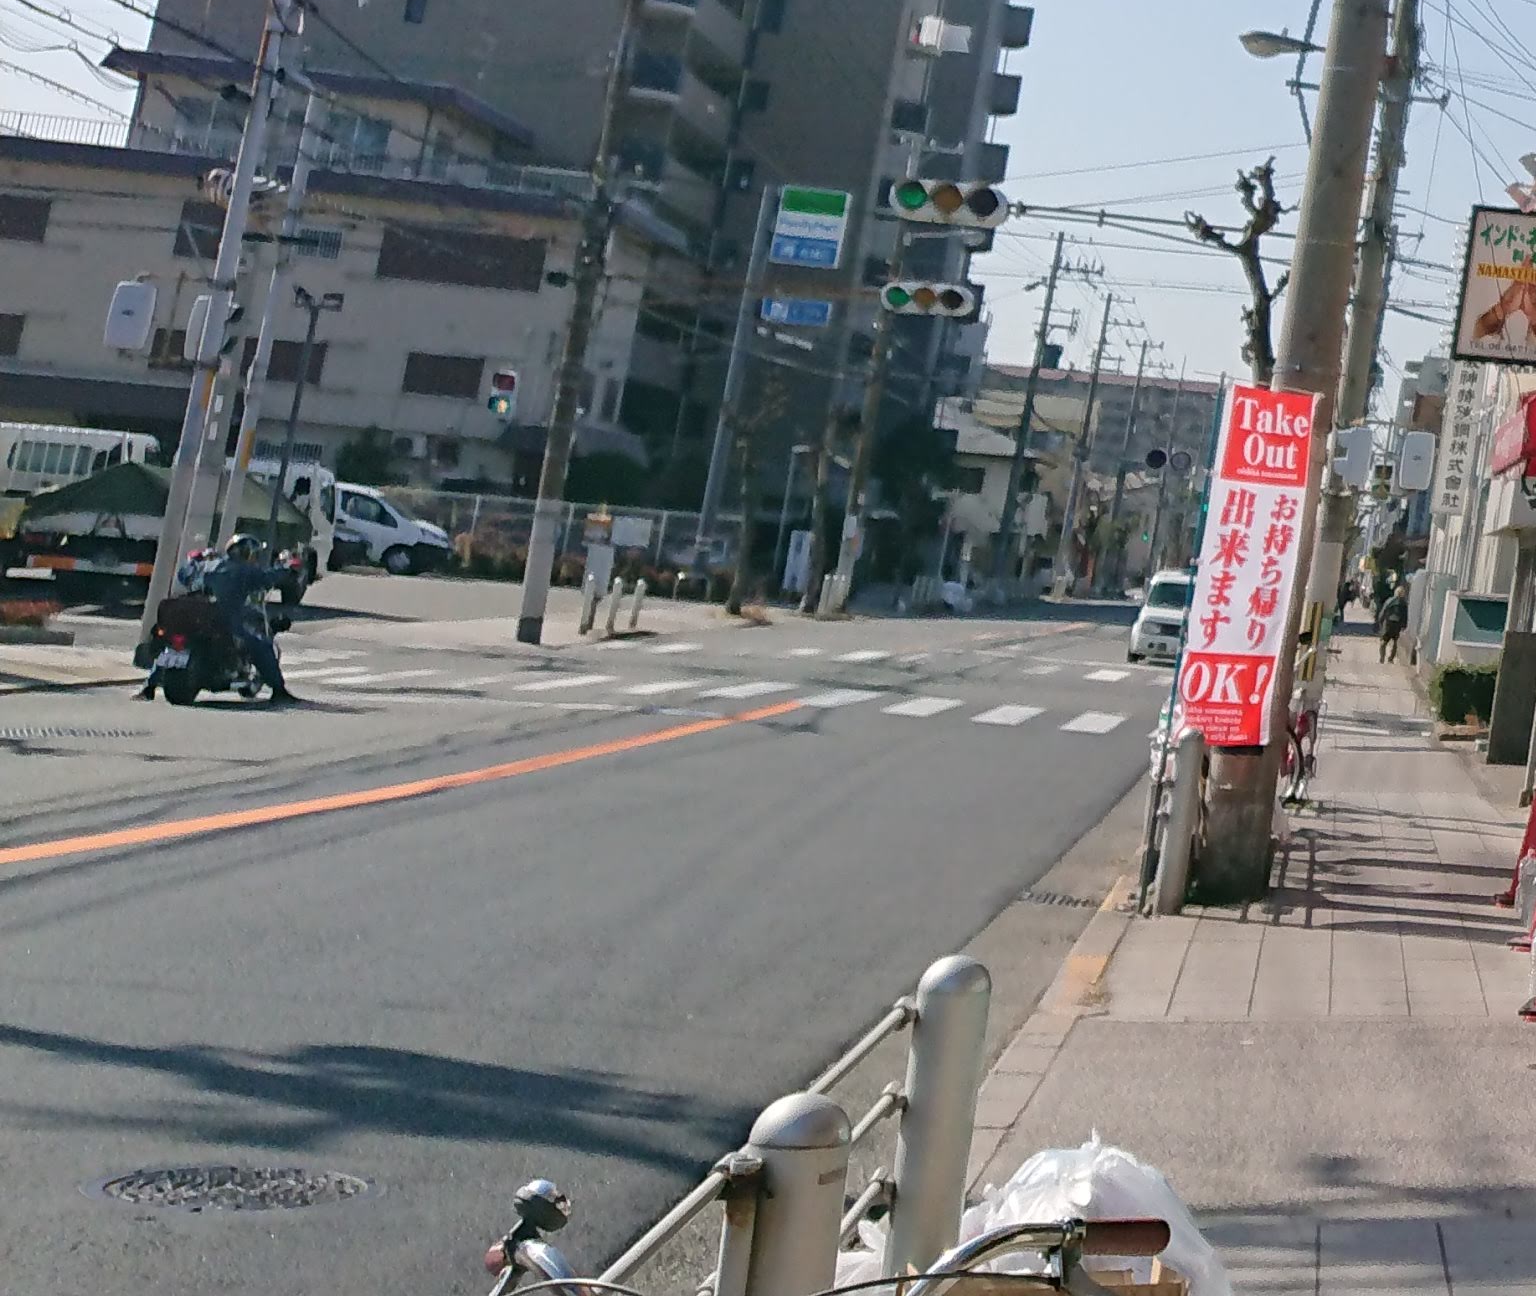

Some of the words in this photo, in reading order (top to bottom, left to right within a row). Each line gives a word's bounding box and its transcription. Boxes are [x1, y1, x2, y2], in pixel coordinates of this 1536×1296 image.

[1237, 396, 1311, 439] Take
[1243, 434, 1297, 470] Out
[1199, 487, 1257, 649] 出来ます
[1247, 493, 1298, 650] お持ち帰り
[1183, 662, 1269, 706] OK!
